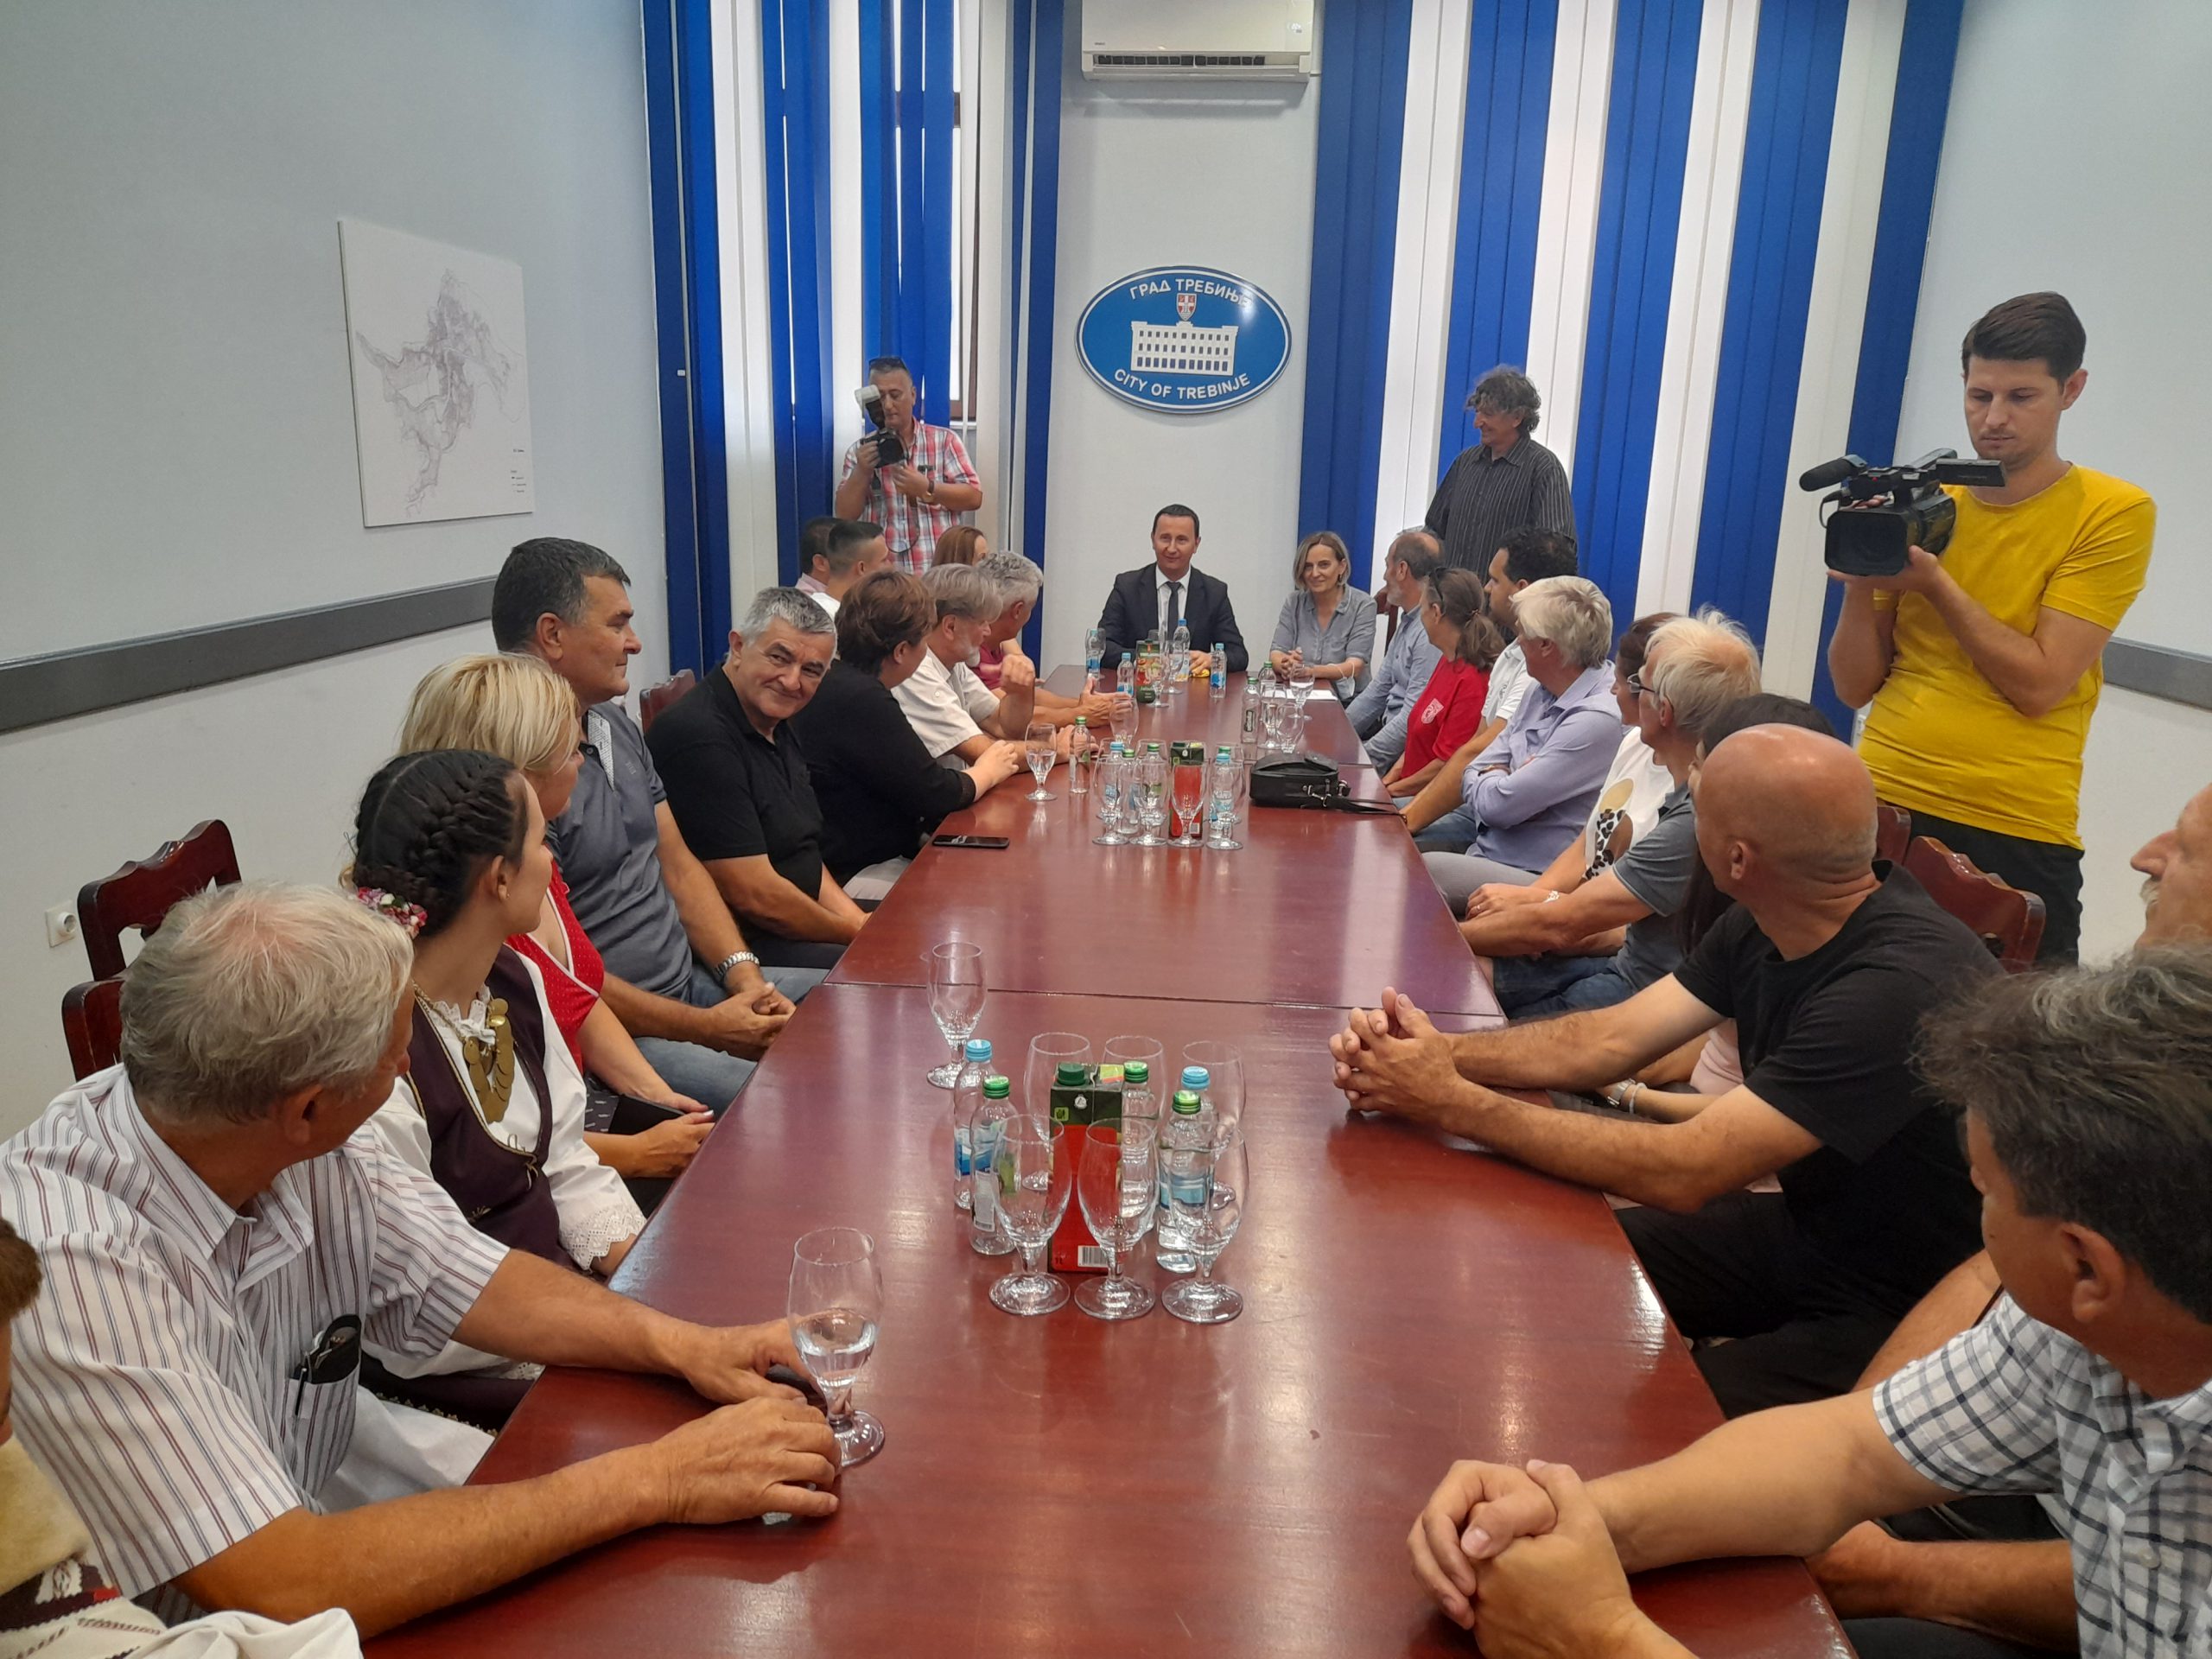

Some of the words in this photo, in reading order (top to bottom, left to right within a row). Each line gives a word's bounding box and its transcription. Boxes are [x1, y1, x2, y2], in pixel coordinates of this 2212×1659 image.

[1130, 280, 1171, 300] ГРАД
[1176, 279, 1252, 308] ТРЕБИЊЕ
[1115, 369, 1147, 391] CITY
[1152, 383, 1172, 397] OF
[1178, 373, 1250, 399] TREBINJE
